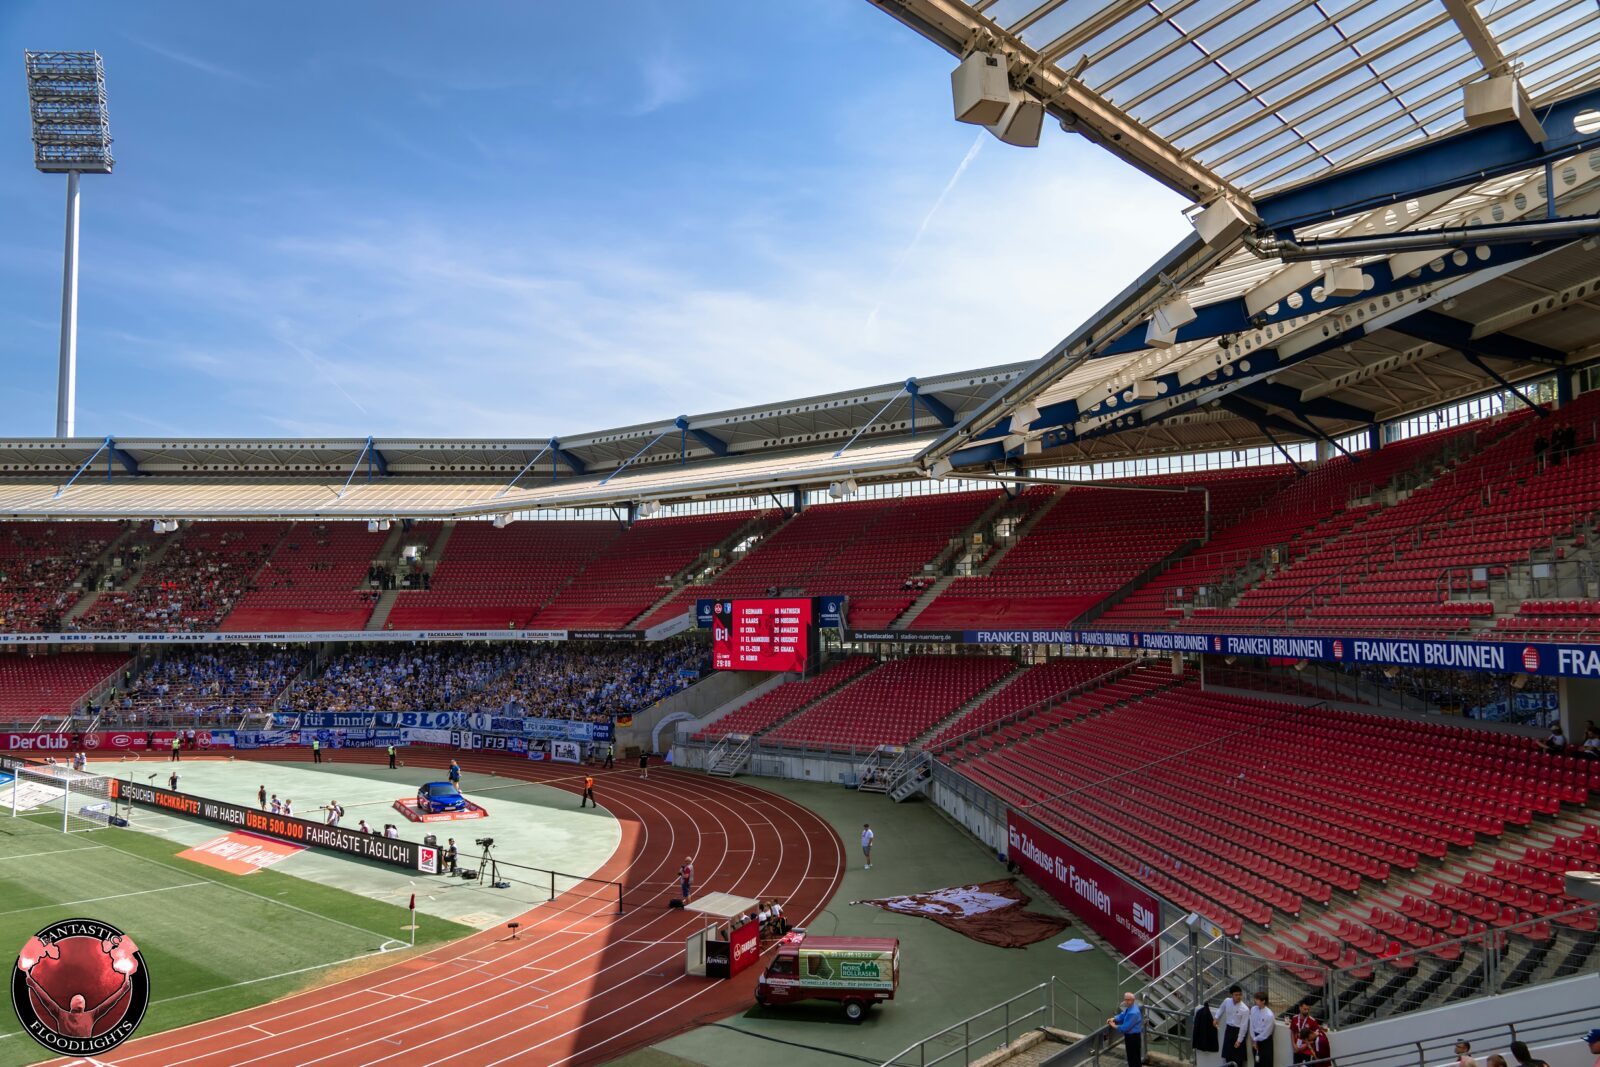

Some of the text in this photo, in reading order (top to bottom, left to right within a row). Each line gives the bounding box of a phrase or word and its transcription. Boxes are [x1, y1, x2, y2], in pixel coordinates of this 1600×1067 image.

[715, 627, 729, 642] 0:1
[900, 634, 951, 642] stadion-nuernberg.de
[977, 631, 1072, 643] FRANKEN BRUNNEN
[1081, 632, 1130, 646] FRANKEN BRUNNEN
[1143, 634, 1208, 651] FRANKEN BRUNNEN
[1227, 637, 1323, 658] FRANKEN BRUNNEN
[1353, 641, 1505, 670] FRANKEN BRUNNEN
[303, 713, 325, 726] für
[9, 733, 69, 750] Der Club
[121, 785, 131, 798] SIE
[132, 787, 155, 804] SUCHEN
[155, 791, 201, 815] FACHKRÄFTE?
[204, 803, 218, 819] WIR
[219, 807, 245, 825] HABEN
[246, 810, 267, 830] ÜBER
[269, 818, 303, 839] 500.000
[306, 826, 361, 852] FAHRGÄSTE
[362, 836, 410, 864] TÄGLICH!
[1009, 824, 1111, 916] Ein Zuhause für Familien
